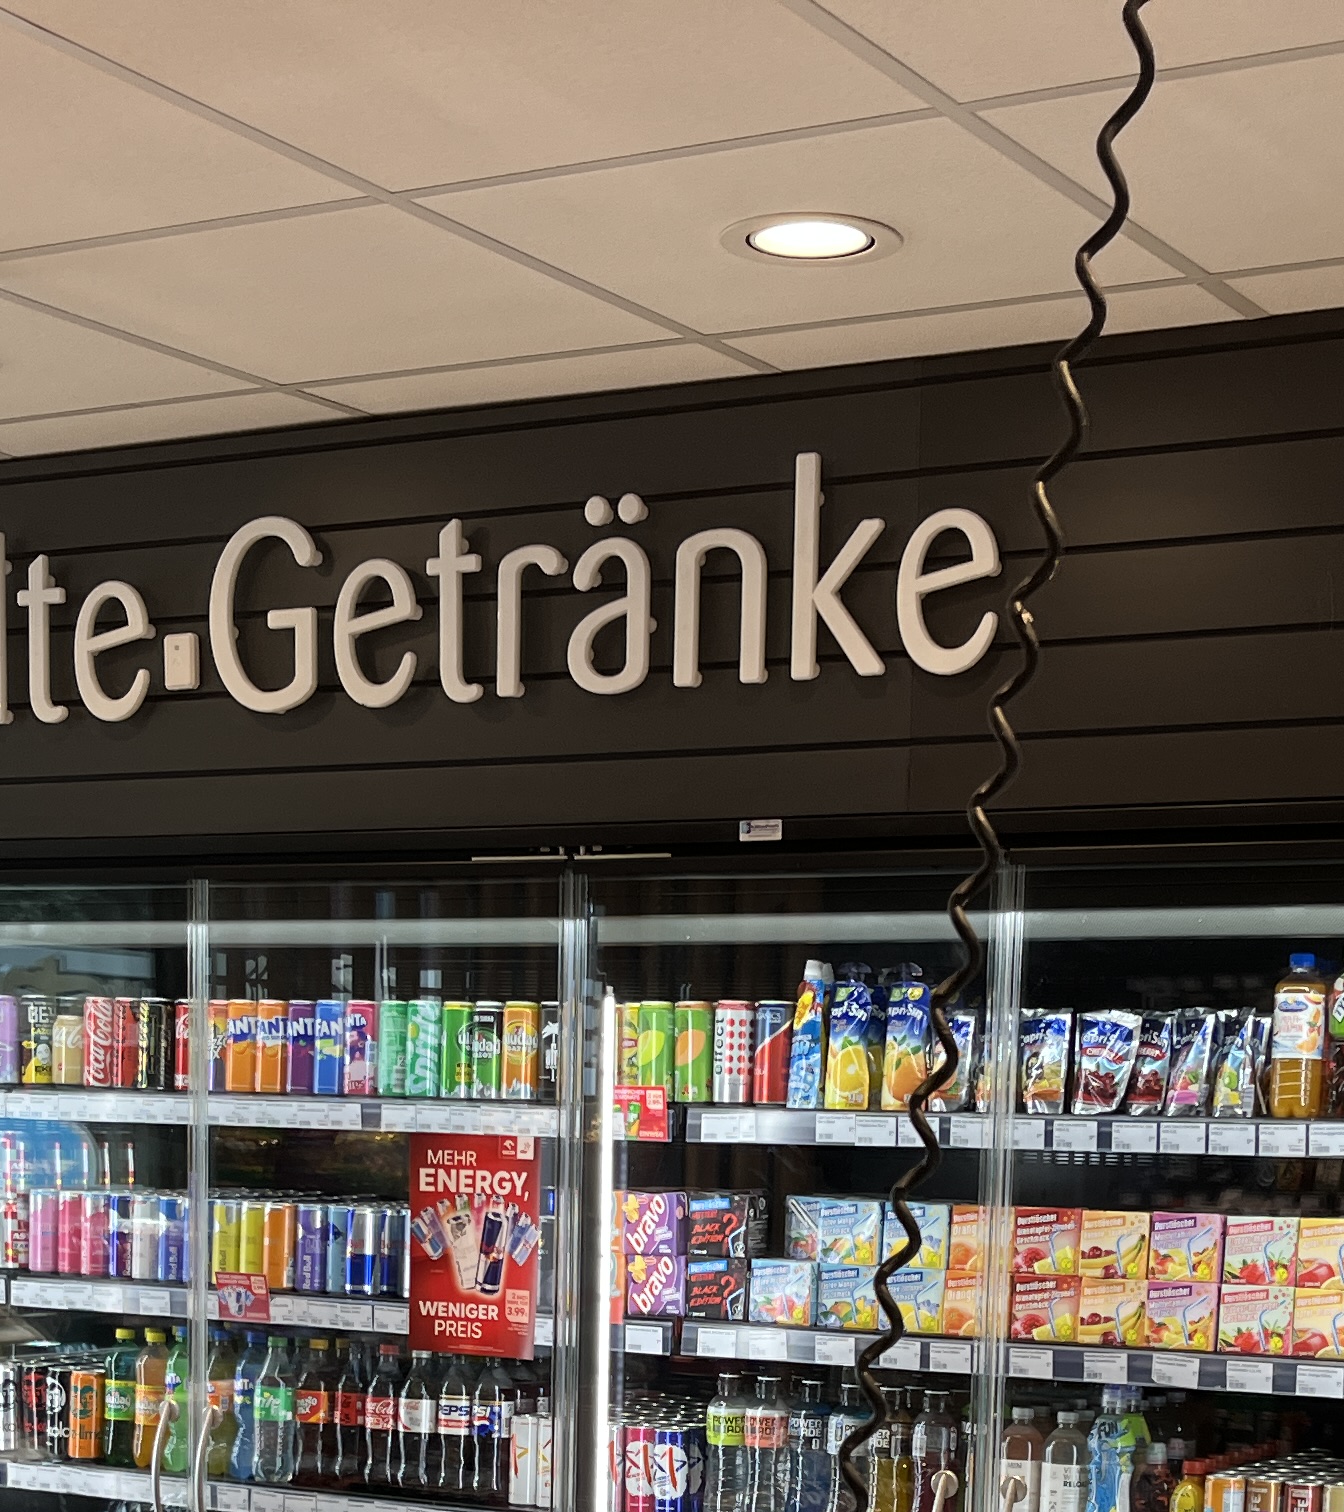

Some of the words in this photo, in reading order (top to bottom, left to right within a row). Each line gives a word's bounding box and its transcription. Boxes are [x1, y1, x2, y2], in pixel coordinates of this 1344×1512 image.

[210, 452, 1001, 713] Getränke
[714, 1017, 725, 1075] effect
[427, 1149, 476, 1166] MEHR
[419, 1168, 529, 1202] ENERGY,
[625, 1195, 665, 1254] bravo
[693, 1223, 719, 1234] BLACK
[631, 1259, 673, 1315] bravo
[693, 1285, 719, 1295] BLACK
[419, 1300, 498, 1321] WENIGER
[435, 1319, 482, 1338] PREIS
